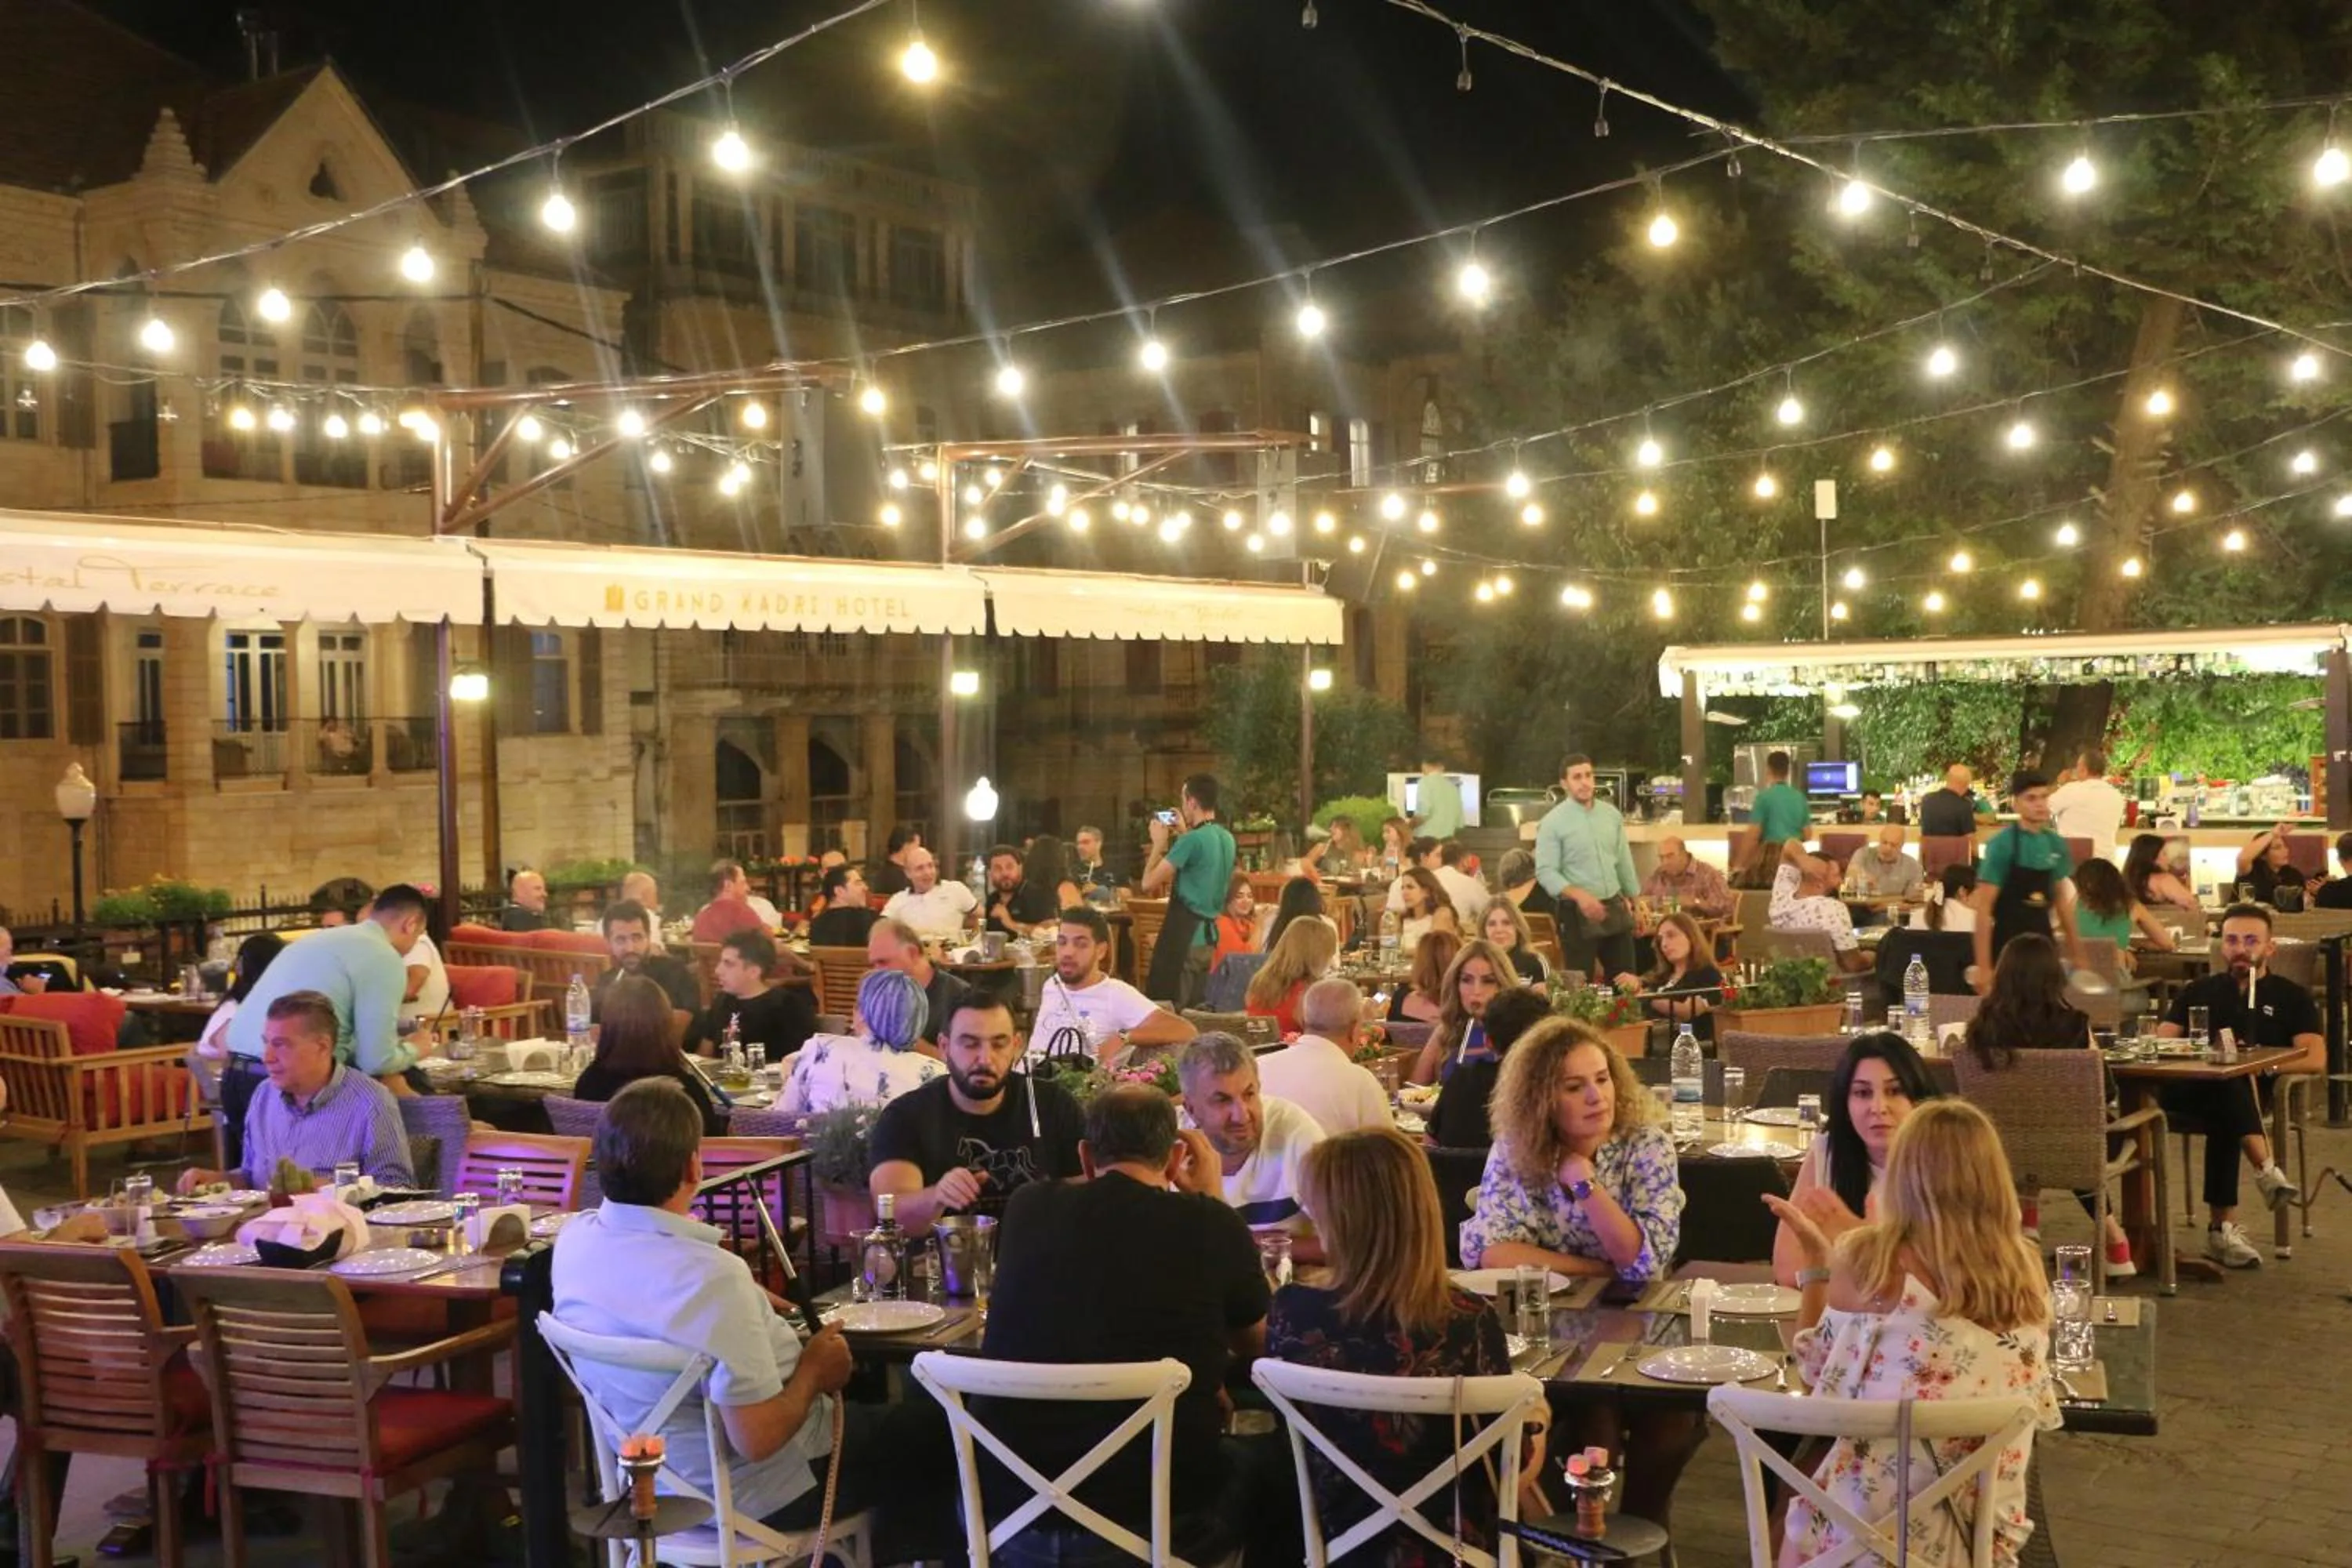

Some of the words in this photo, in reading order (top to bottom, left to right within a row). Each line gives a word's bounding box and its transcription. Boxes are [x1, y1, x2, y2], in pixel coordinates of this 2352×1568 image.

[78, 554, 281, 597] Terrace
[634, 589, 724, 613] GRAND
[741, 593, 818, 616] KADRI
[836, 596, 910, 618] HOTEL
